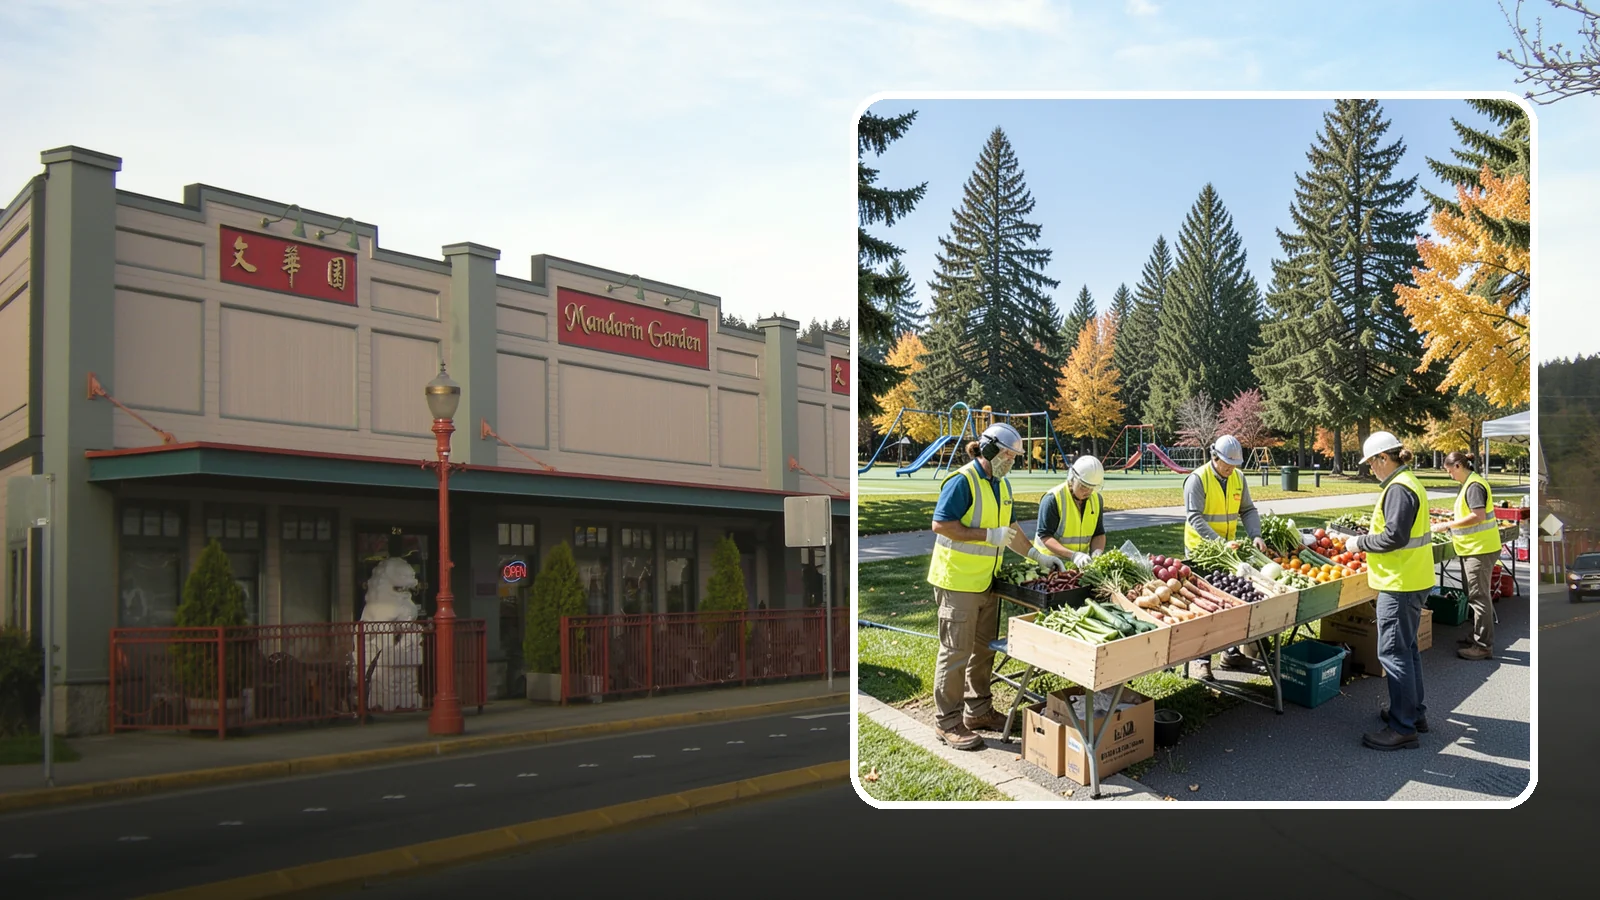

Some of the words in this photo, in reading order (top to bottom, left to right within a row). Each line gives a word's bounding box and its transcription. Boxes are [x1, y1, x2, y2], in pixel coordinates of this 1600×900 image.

[231, 235, 346, 291] 文華園
[564, 302, 644, 340] Mandarin
[648, 320, 702, 352] Garden
[503, 565, 526, 578] OPEN
